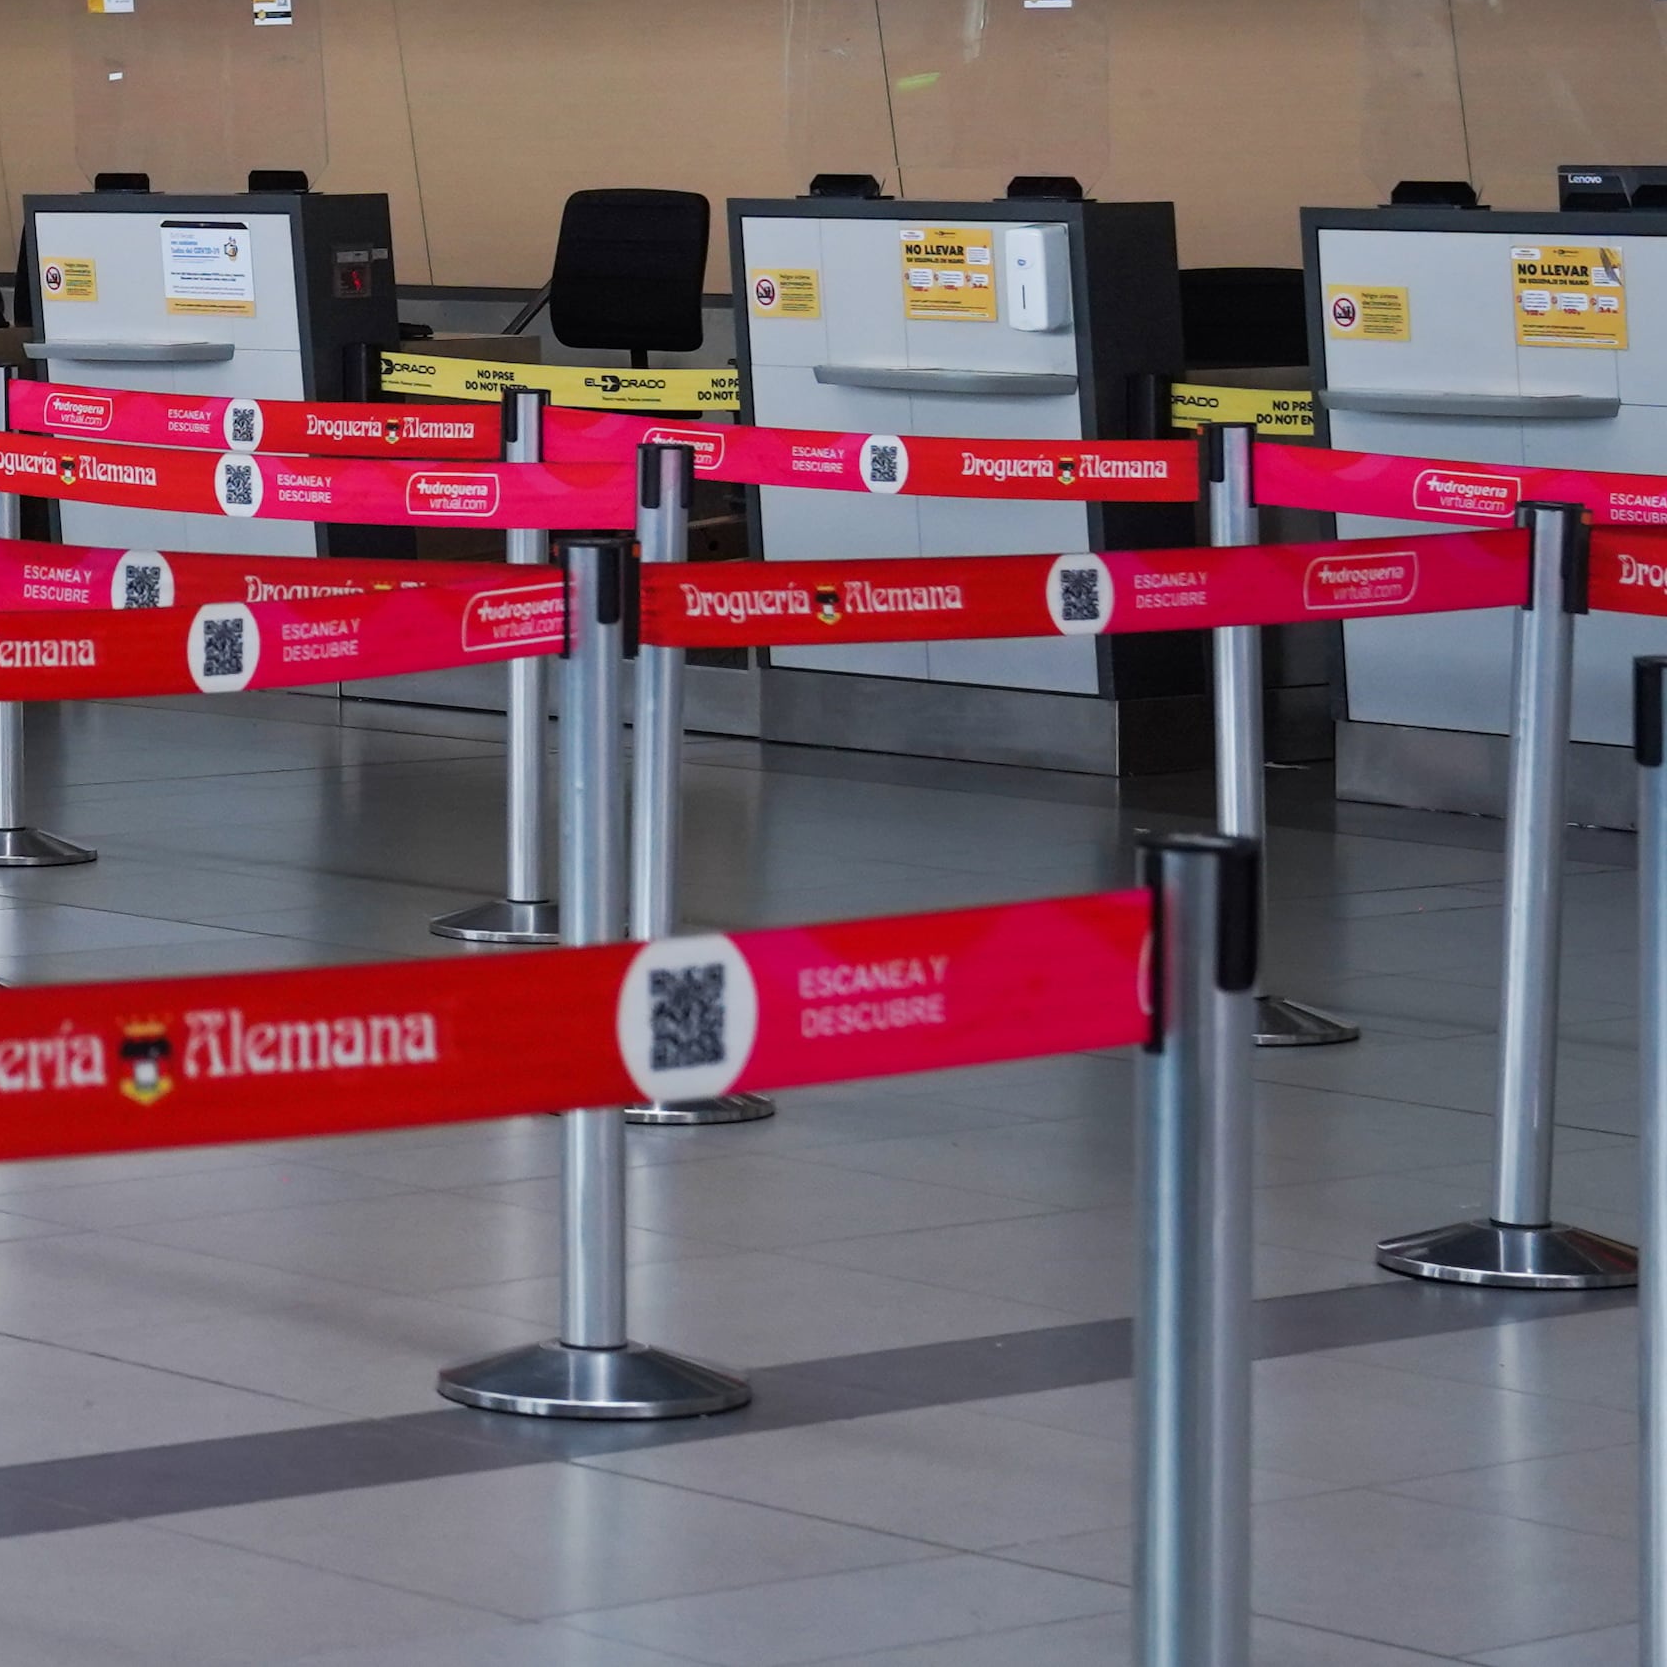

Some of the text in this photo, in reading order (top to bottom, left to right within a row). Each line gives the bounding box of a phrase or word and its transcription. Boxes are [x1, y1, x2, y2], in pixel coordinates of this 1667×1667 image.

[1568, 173, 1602, 183] Lenovo
[905, 244, 964, 256] NO LLEVAR
[1517, 264, 1589, 277] NO LLEVAR
[477, 369, 491, 380] NO
[601, 375, 666, 392] DORADO
[465, 380, 478, 391] DO
[479, 381, 499, 393] NOT
[1273, 400, 1314, 412] NO PAS
[306, 415, 475, 442] Droguería Alemana
[1256, 413, 1299, 425] DO NOT
[78, 461, 157, 487] Alemana
[962, 450, 1168, 481] Droguería Alemana
[277, 473, 320, 487] ESCANEA
[278, 489, 331, 504] DESCUBRE
[23, 565, 93, 585] ESCANEA Y
[1134, 574, 1192, 591] ESCANEA
[23, 583, 90, 604] DESCUBRE
[684, 583, 963, 622] Droguería Alemana
[1135, 590, 1207, 609] DESCUBRE
[281, 619, 360, 641] ESCANEA Y
[283, 640, 359, 663] DESCUBRE
[798, 955, 950, 1002] ESCANEA Y
[801, 992, 949, 1039] DESCUBRE
[183, 1010, 438, 1080] Alemana
